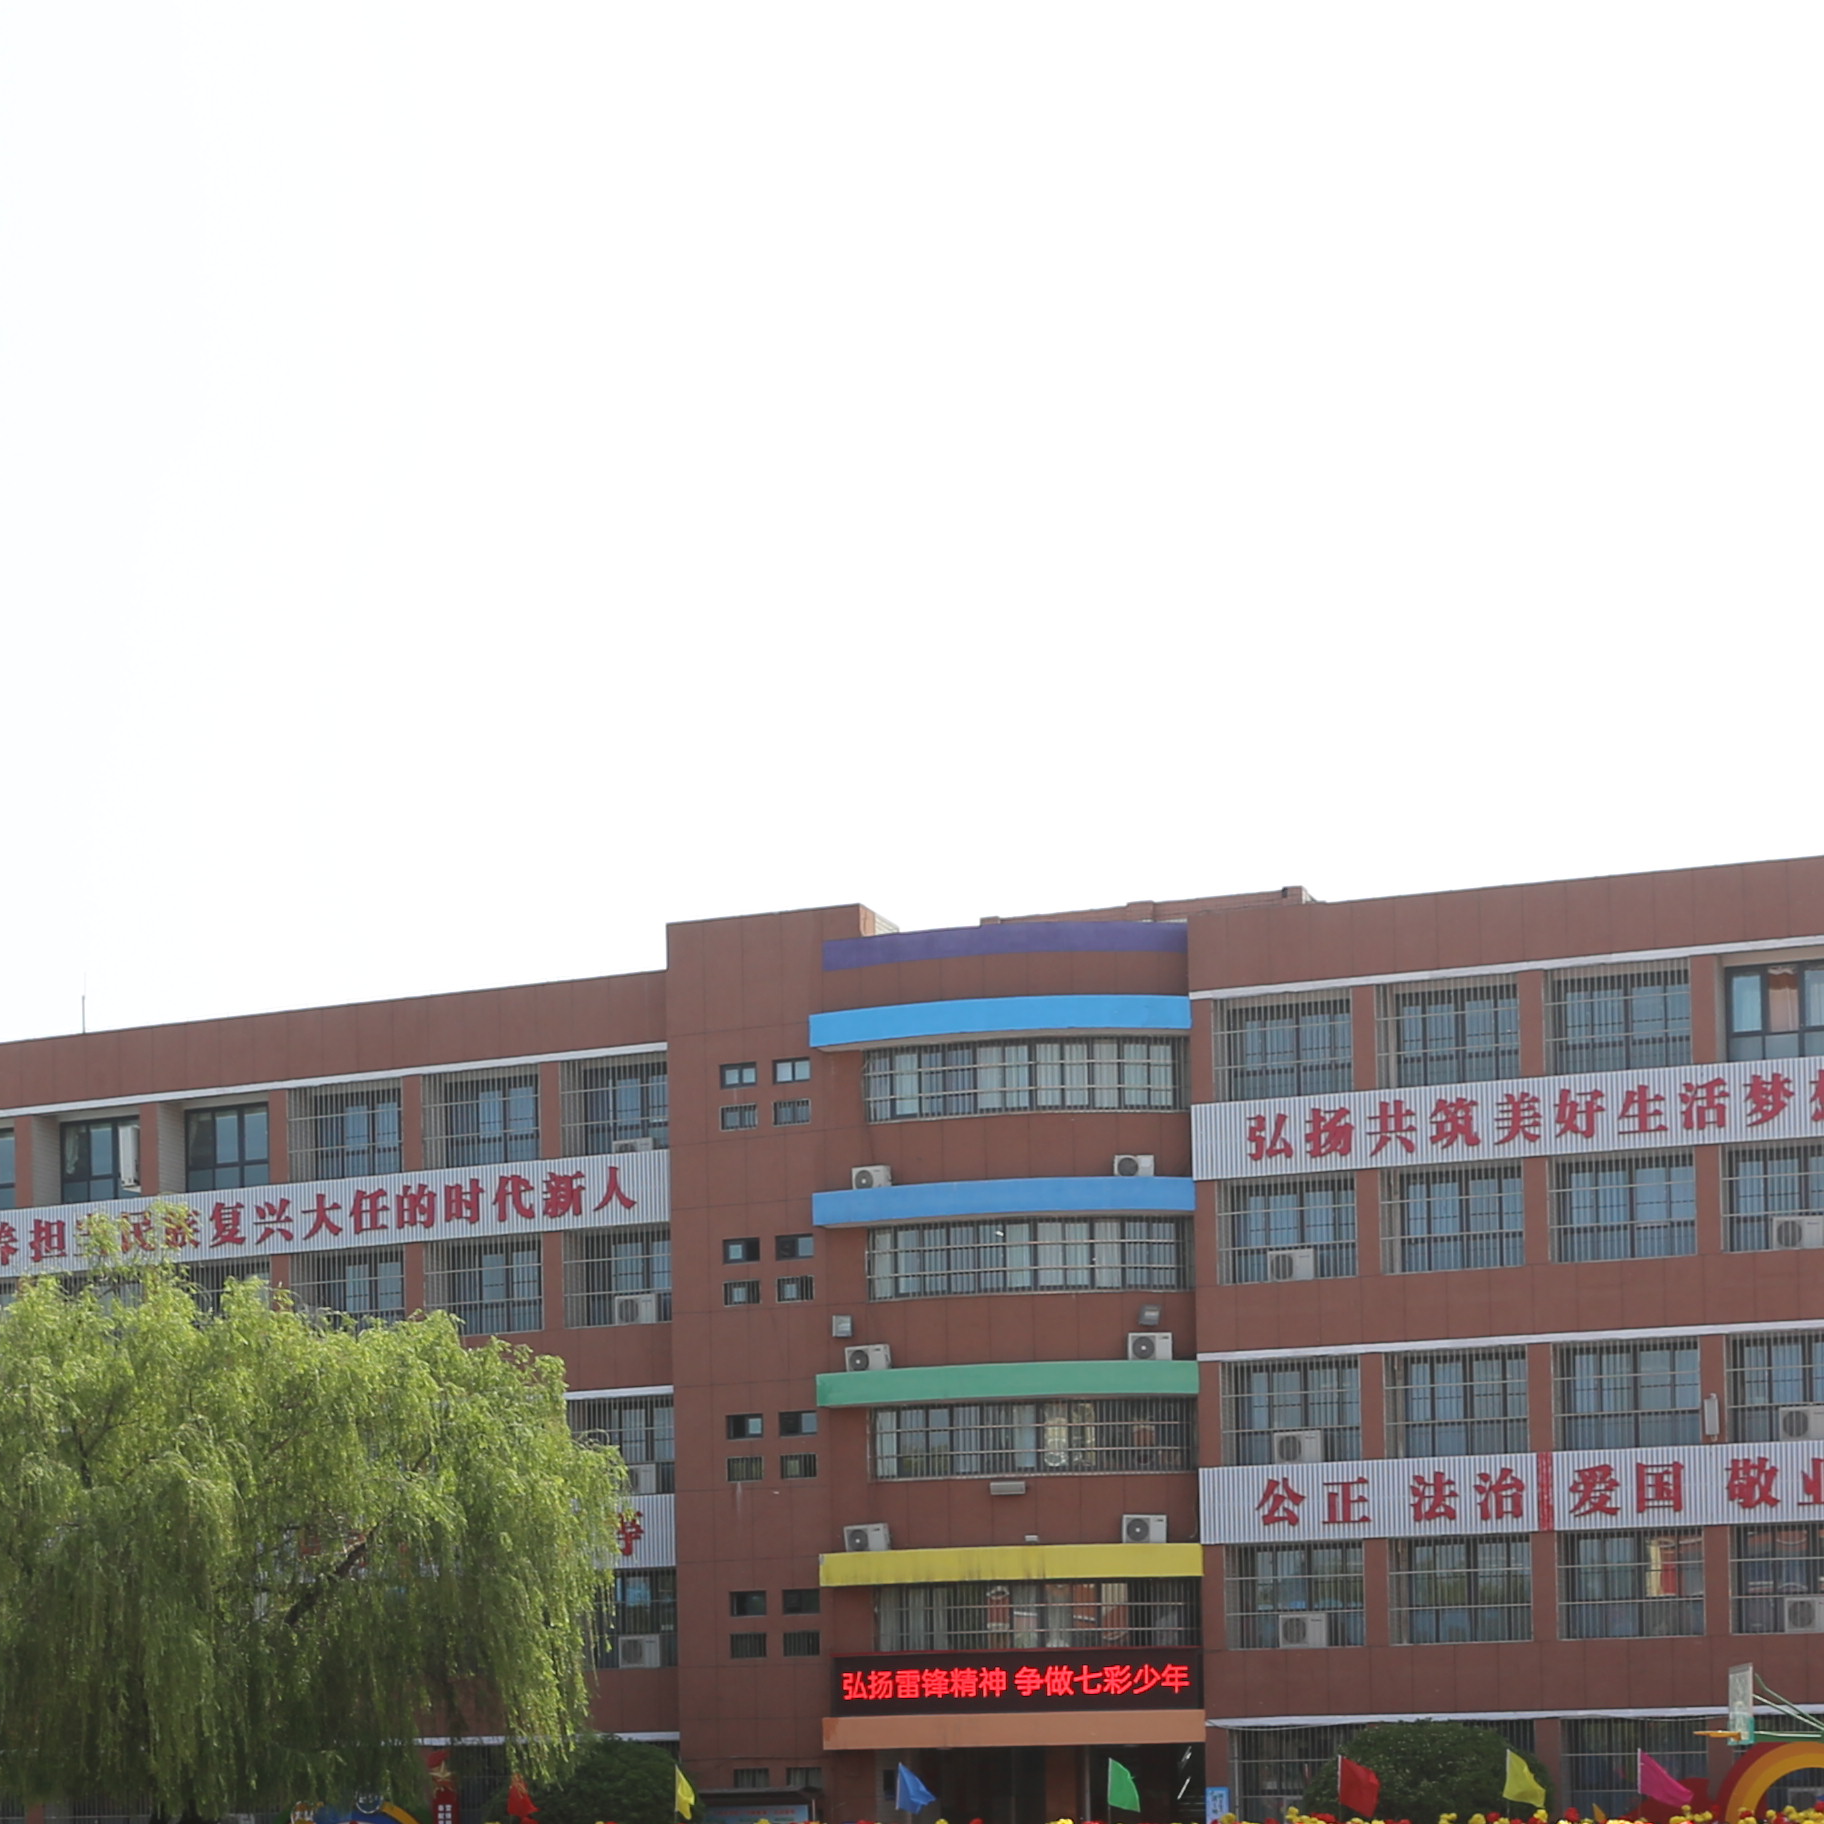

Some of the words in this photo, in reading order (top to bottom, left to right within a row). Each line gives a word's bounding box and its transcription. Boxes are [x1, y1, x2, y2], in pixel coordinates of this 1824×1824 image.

[1255, 1475, 1372, 1529] 公正
[1409, 1468, 1526, 1522] 法治
[1569, 1460, 1685, 1517] 爱国
[842, 1667, 1007, 1700] 弘扬雷锋精神
[1014, 1663, 1190, 1697] 争做七彩少年
